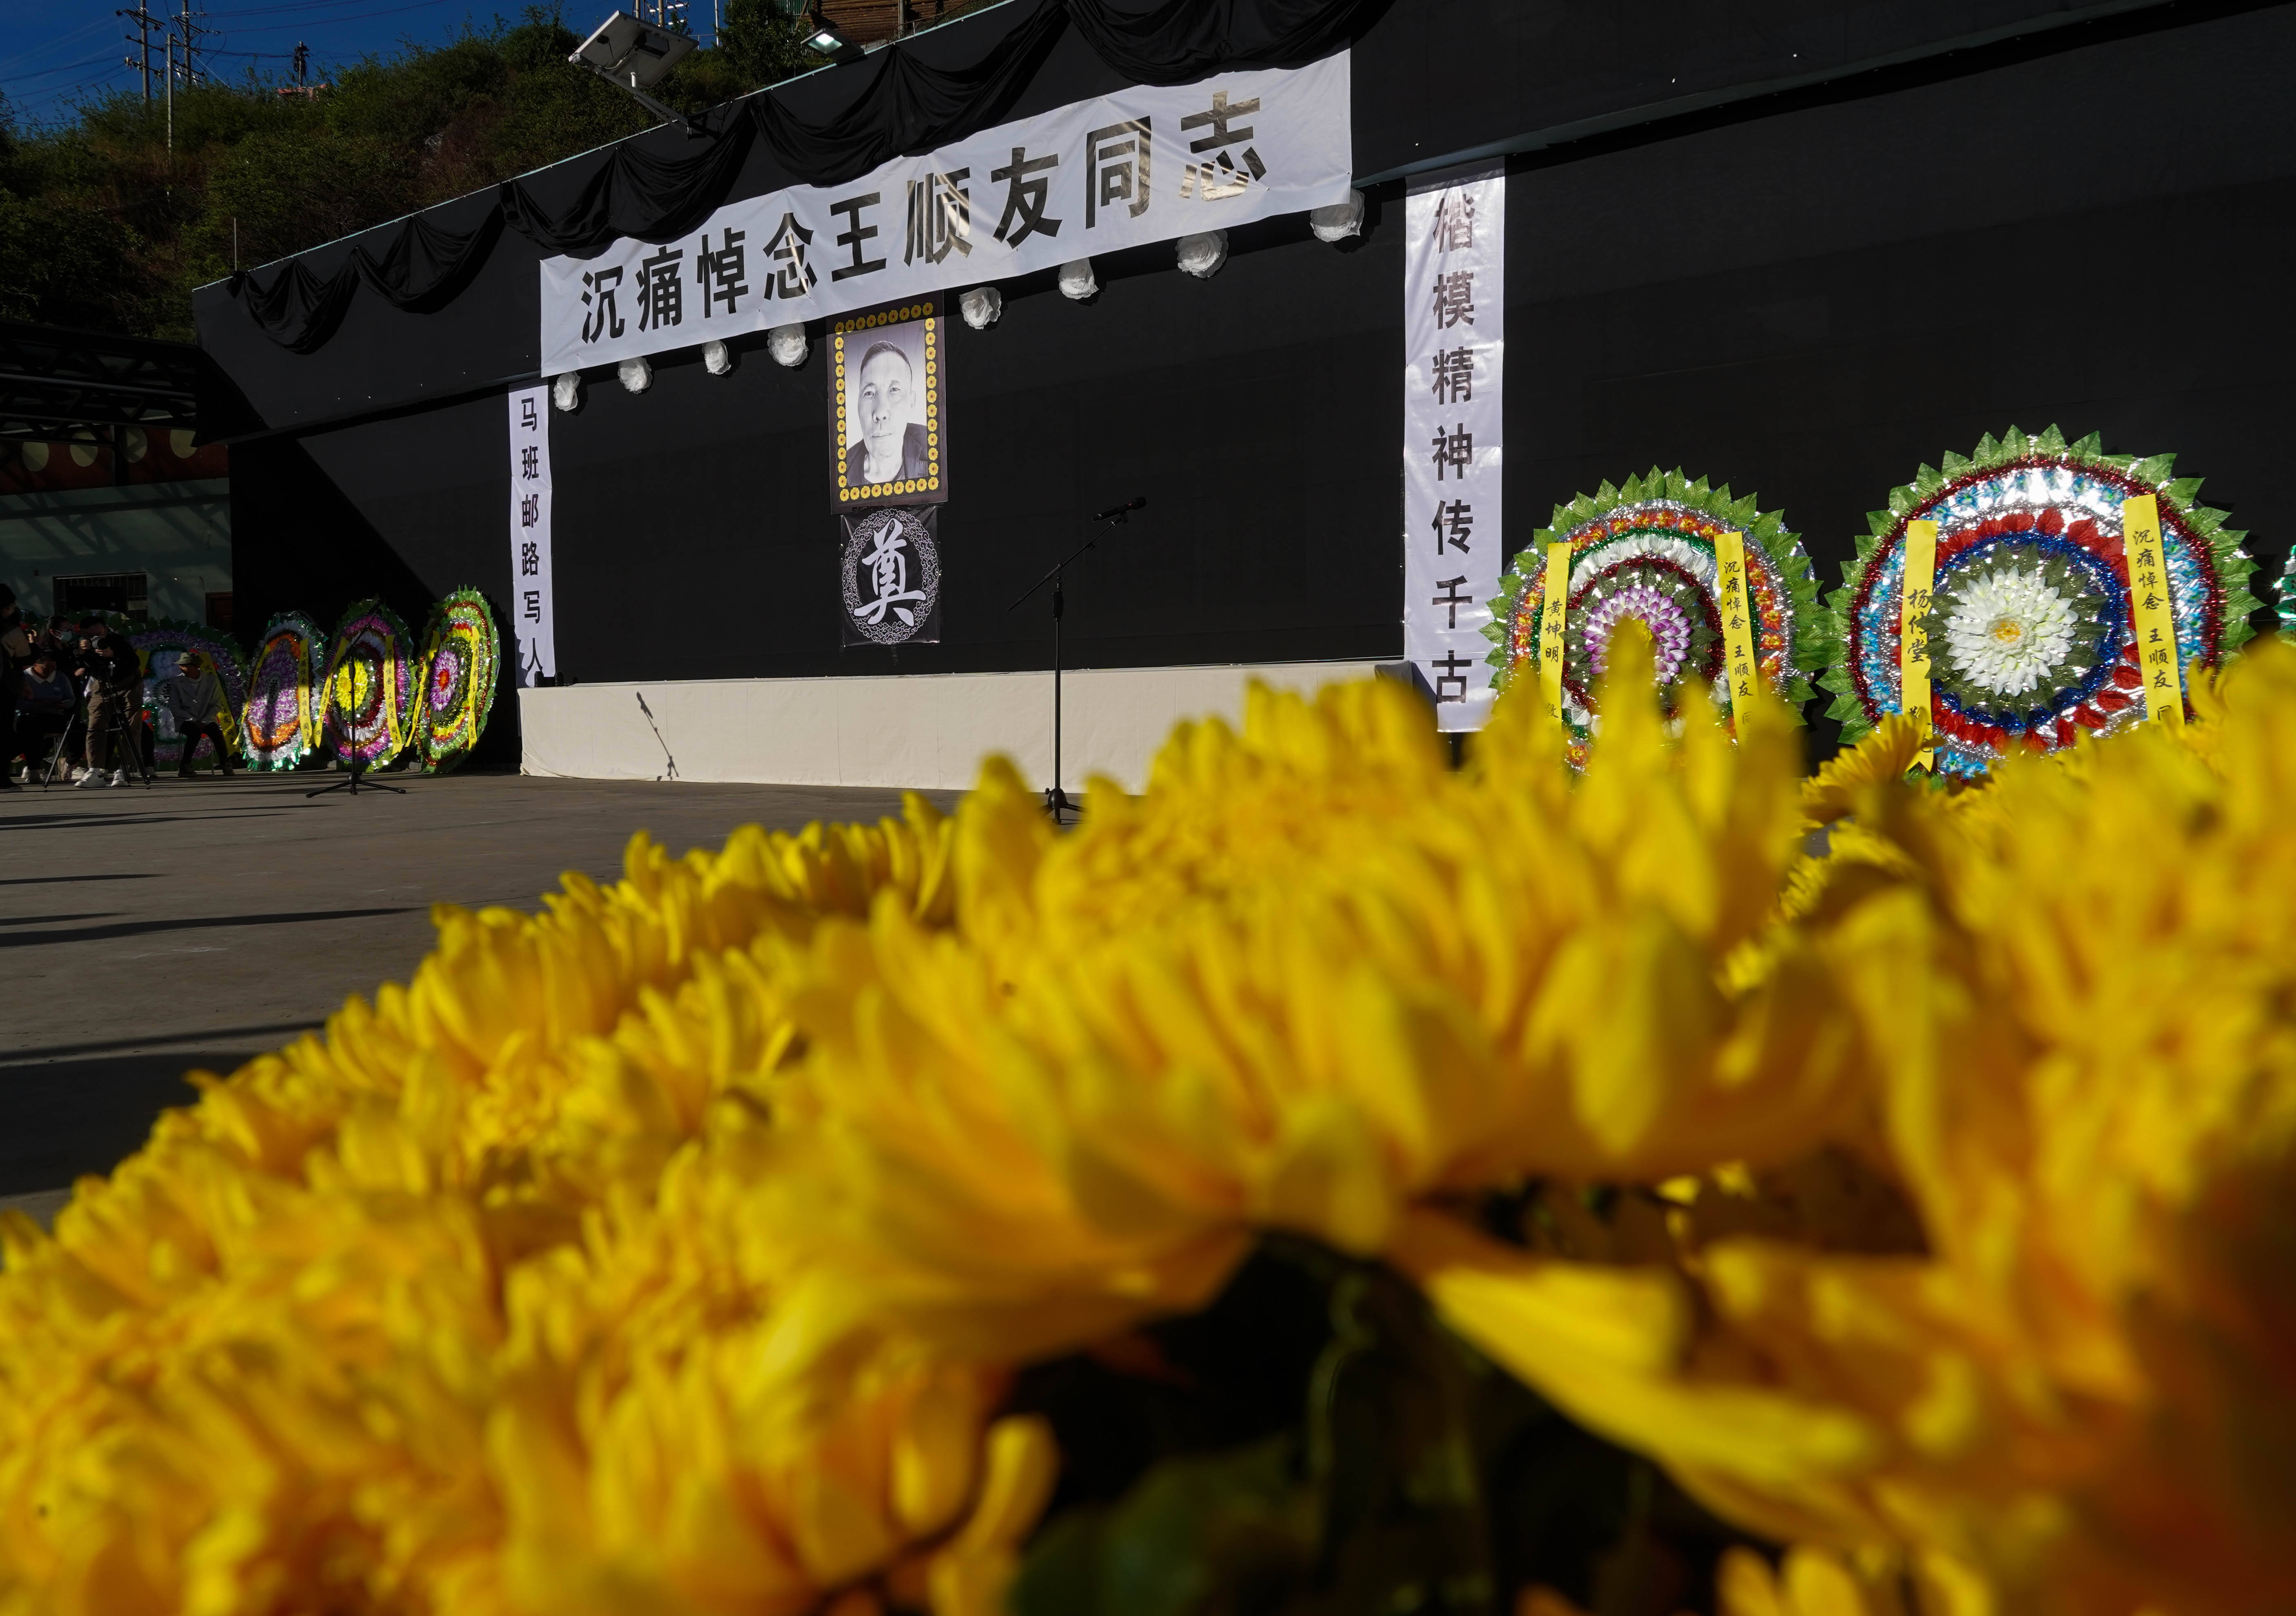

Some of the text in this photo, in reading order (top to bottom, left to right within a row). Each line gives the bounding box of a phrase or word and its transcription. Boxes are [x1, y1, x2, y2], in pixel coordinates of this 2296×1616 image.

[581, 90, 1267, 344] 沉痛悼念王顺友同志
[1432, 193, 1475, 704] 楷模精神传千古
[853, 518, 926, 627] 奠
[1545, 598, 1563, 663] 黄坤明
